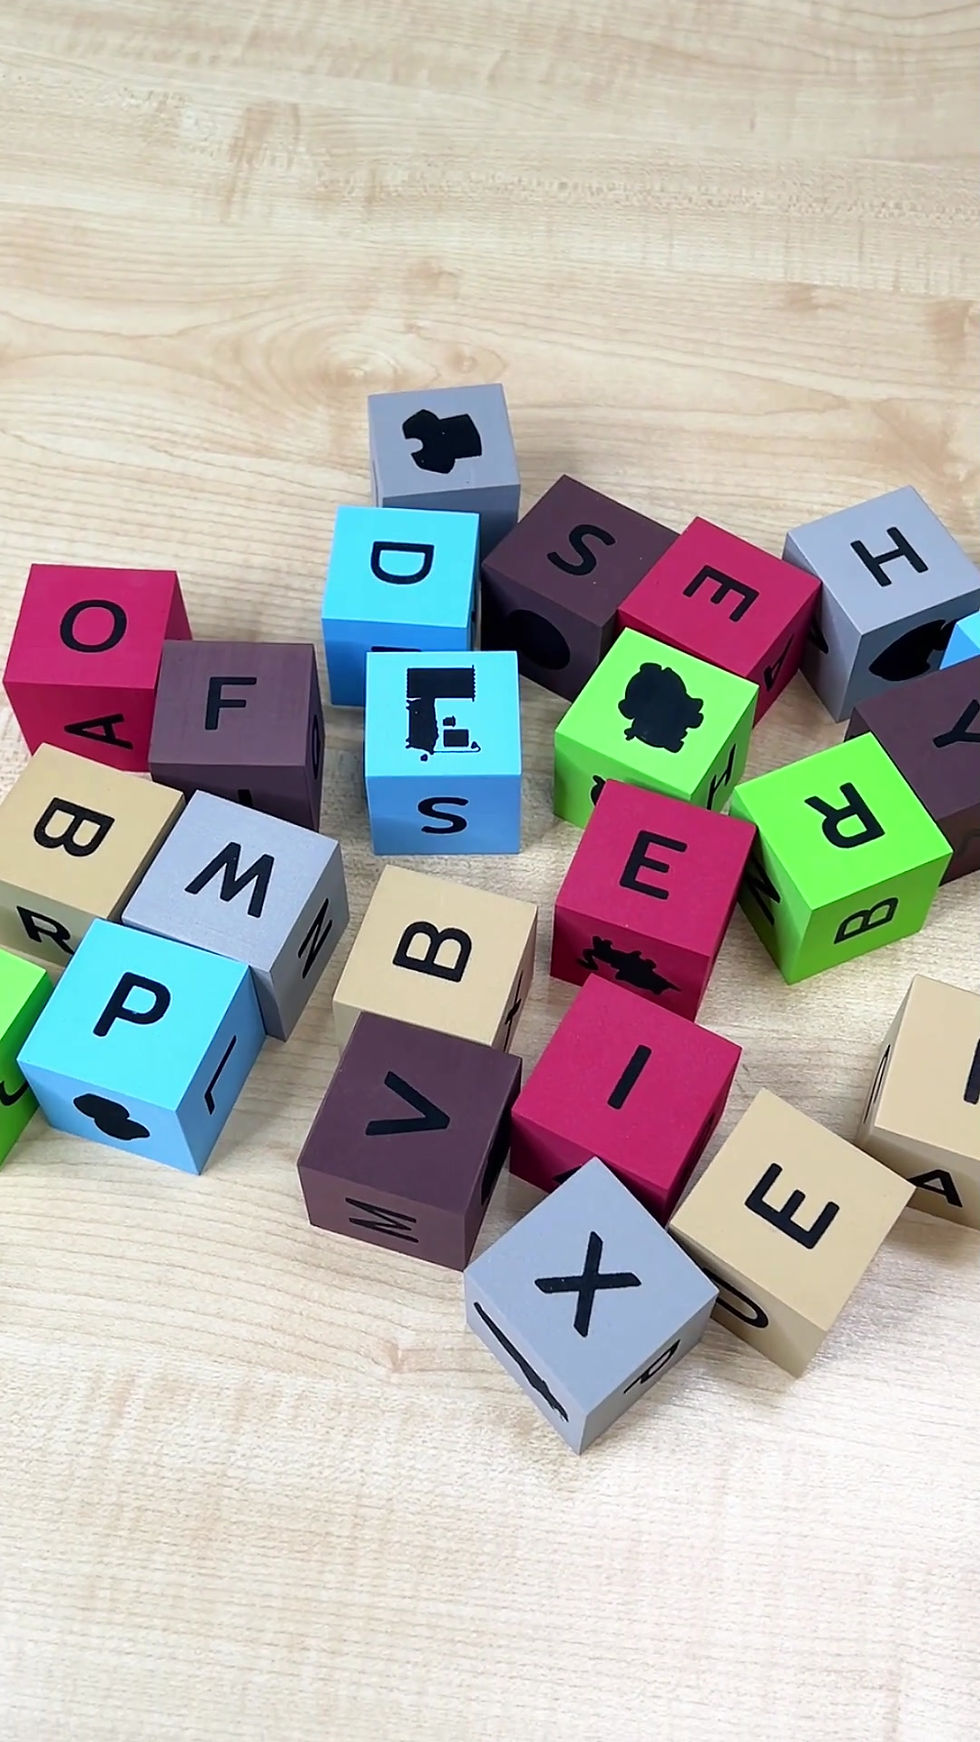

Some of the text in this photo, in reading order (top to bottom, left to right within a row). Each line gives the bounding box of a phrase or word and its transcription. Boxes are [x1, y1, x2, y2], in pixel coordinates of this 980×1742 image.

[371, 542, 434, 584] D
[547, 525, 615, 575] S
[851, 527, 928, 586] H
[683, 566, 759, 622] E
[60, 600, 127, 652] O
[65, 714, 133, 749] A
[205, 677, 257, 730] F
[933, 700, 980, 748] Y
[34, 798, 115, 856] B
[418, 797, 468, 834] S
[805, 783, 885, 848] R
[620, 831, 687, 899] E
[17, 906, 75, 955] R
[834, 898, 898, 944] B
[393, 922, 471, 982] B
[94, 973, 170, 1036] P
[205, 1036, 236, 1114] L
[366, 1071, 450, 1135] V
[608, 1045, 651, 1109] I
[745, 1163, 839, 1249] E
[906, 1170, 962, 1207] A
[346, 1198, 418, 1243] M
[535, 1232, 641, 1337] X
